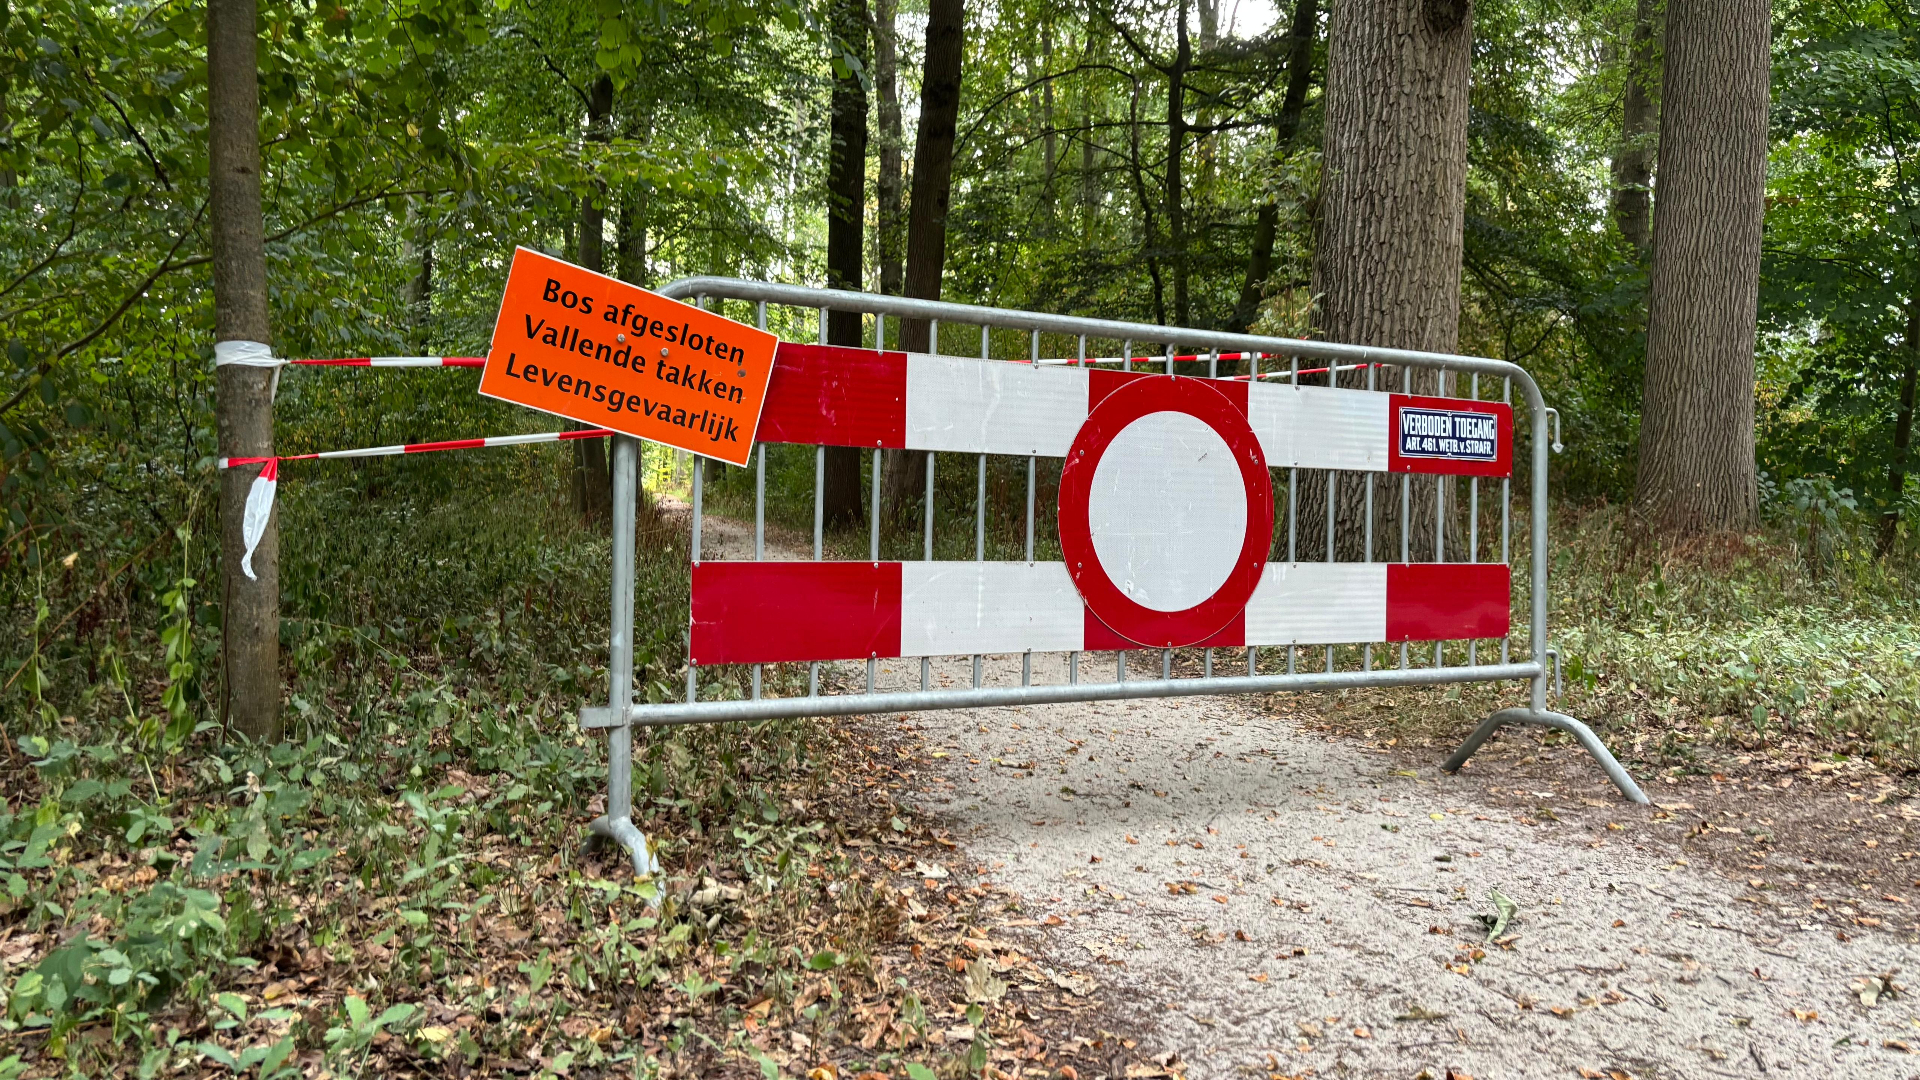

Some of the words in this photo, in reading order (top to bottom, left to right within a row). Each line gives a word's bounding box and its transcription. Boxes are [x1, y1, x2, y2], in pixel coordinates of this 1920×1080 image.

[525, 314, 646, 373] Vallende
[656, 359, 743, 404] takken
[543, 278, 594, 315] Bos
[603, 304, 745, 364] afgesloten
[505, 353, 739, 443] Levensgevaarlijk
[1403, 414, 1452, 436] VERBODEN
[1454, 418, 1494, 439] TOEGANG
